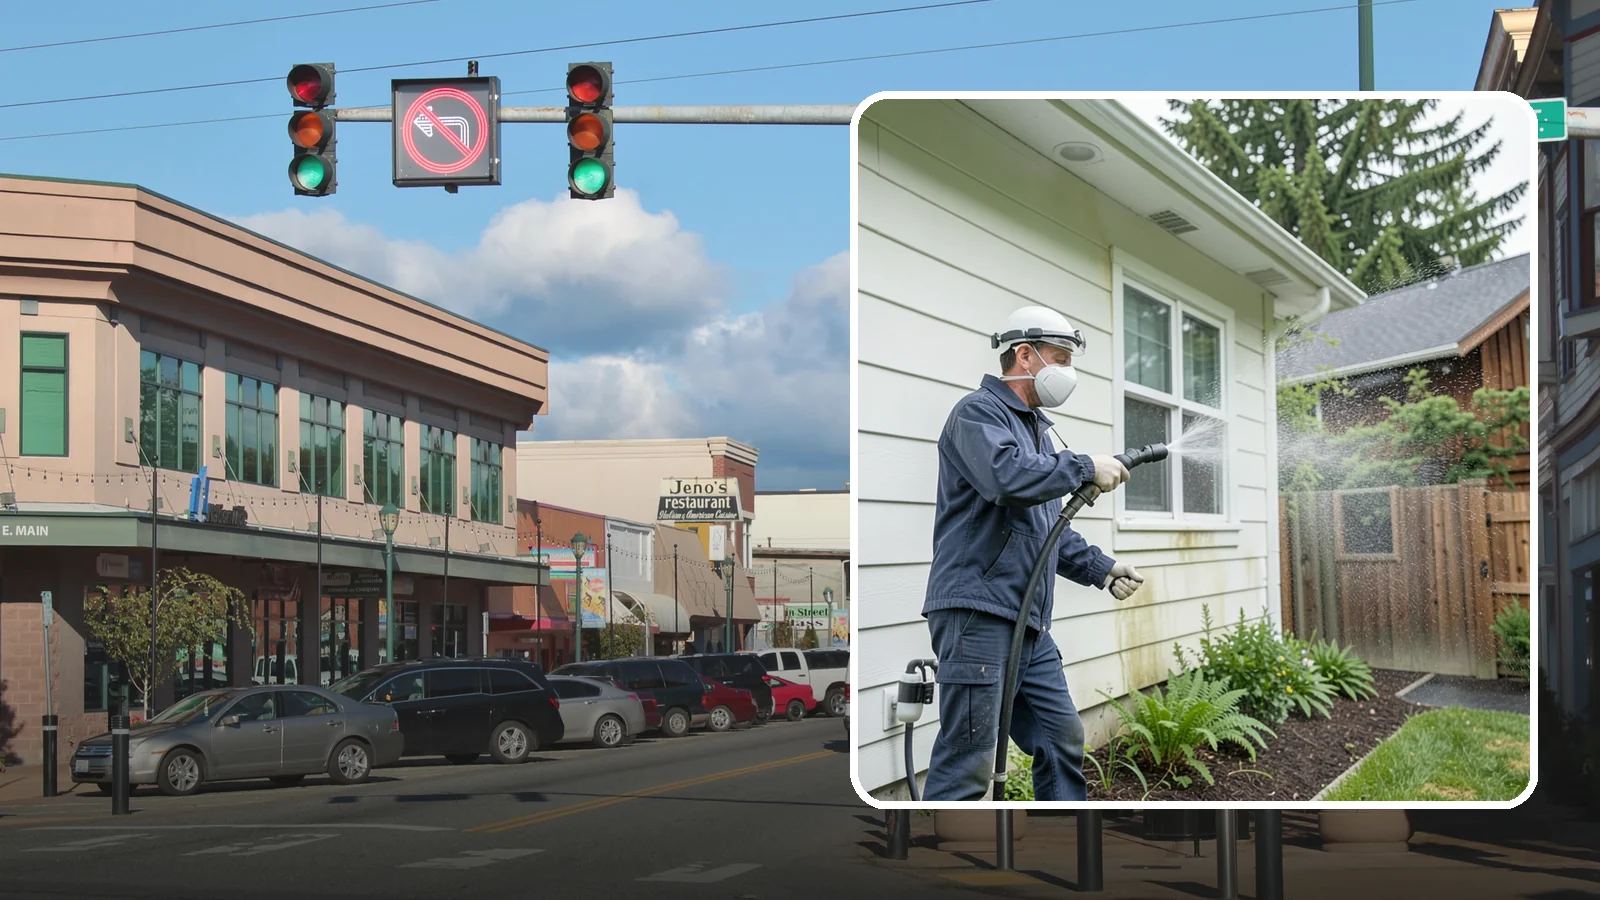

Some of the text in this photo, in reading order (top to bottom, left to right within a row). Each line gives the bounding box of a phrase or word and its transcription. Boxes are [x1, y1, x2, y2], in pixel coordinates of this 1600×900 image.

[670, 480, 727, 494] Jeno's
[666, 496, 730, 508] restaurant
[658, 510, 682, 520] Italian
[686, 510, 714, 519] American
[715, 509, 737, 519] Cuisine
[2, 525, 48, 536] E. MAIN
[797, 607, 828, 616] Street
